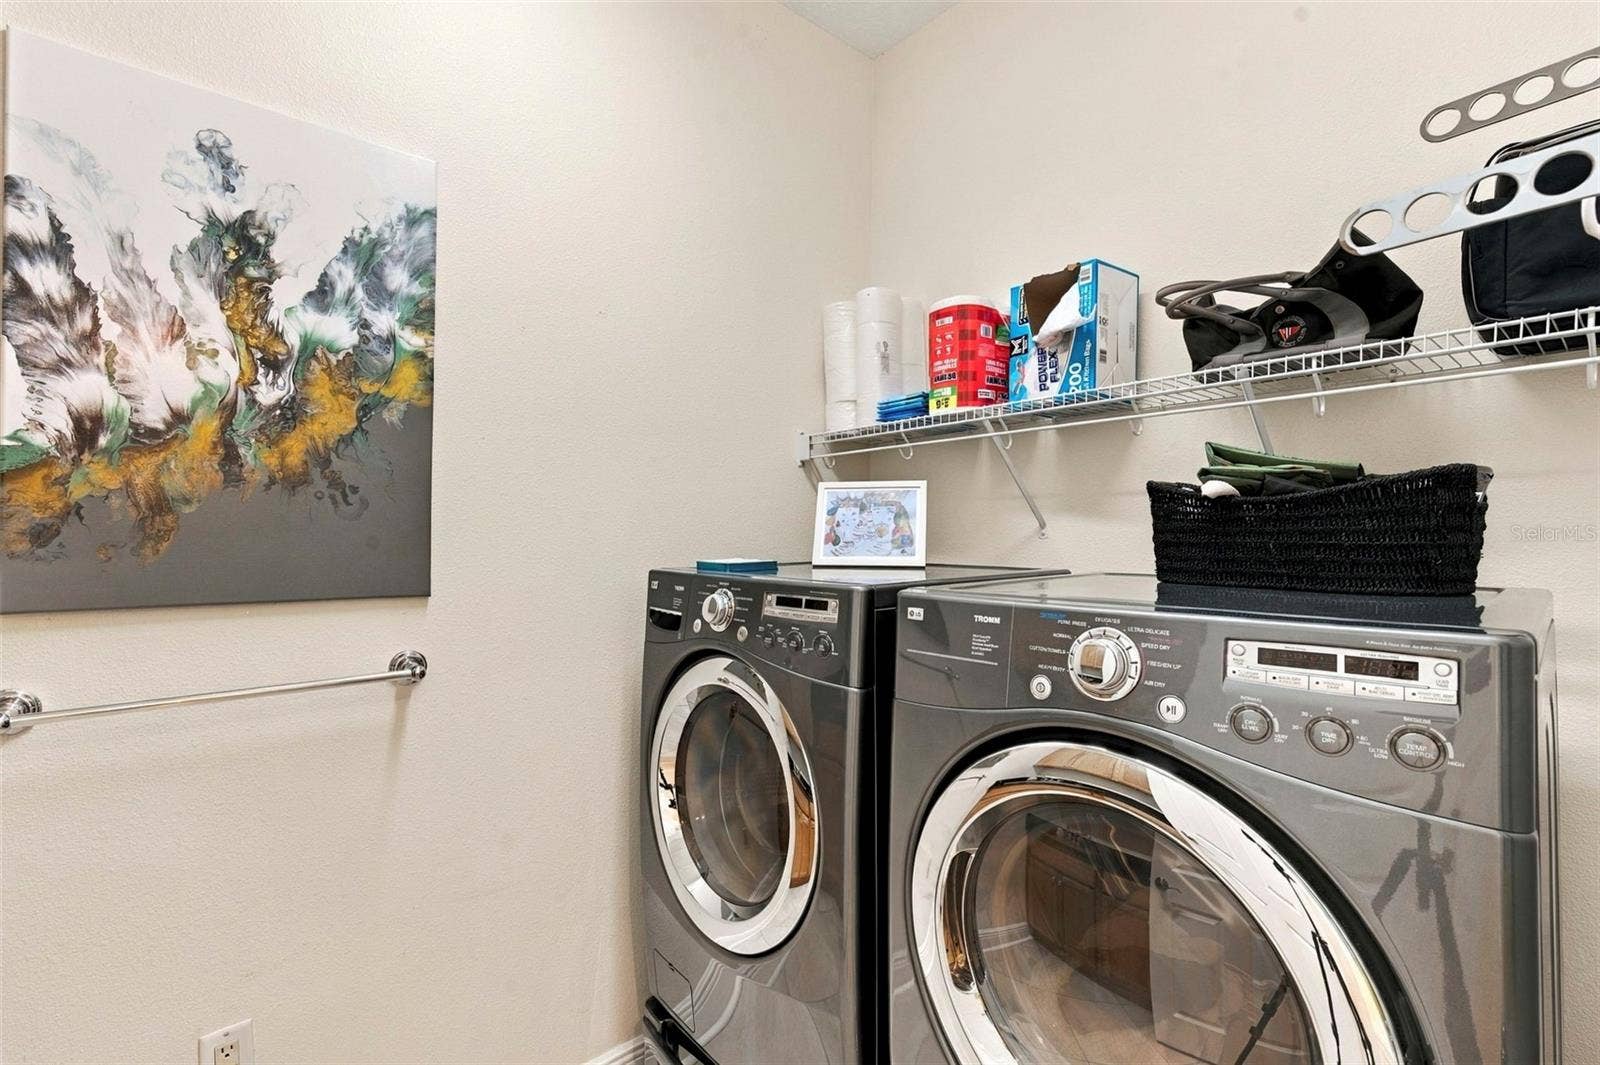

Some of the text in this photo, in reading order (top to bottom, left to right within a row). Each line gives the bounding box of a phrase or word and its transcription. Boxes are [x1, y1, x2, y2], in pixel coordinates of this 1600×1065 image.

[1084, 339, 1092, 357] Bags
[1048, 349, 1060, 383] FLEX
[1069, 362, 1081, 393] 200
[1145, 628, 1170, 636] DELICATE
[1141, 642, 1159, 650] SPEED
[1147, 660, 1172, 669] FRESHEN
[1321, 731, 1337, 740] TIME
[1368, 747, 1389, 755] ULTRA
[1406, 743, 1428, 752] TEMP
[1398, 748, 1436, 759] CONTROL
